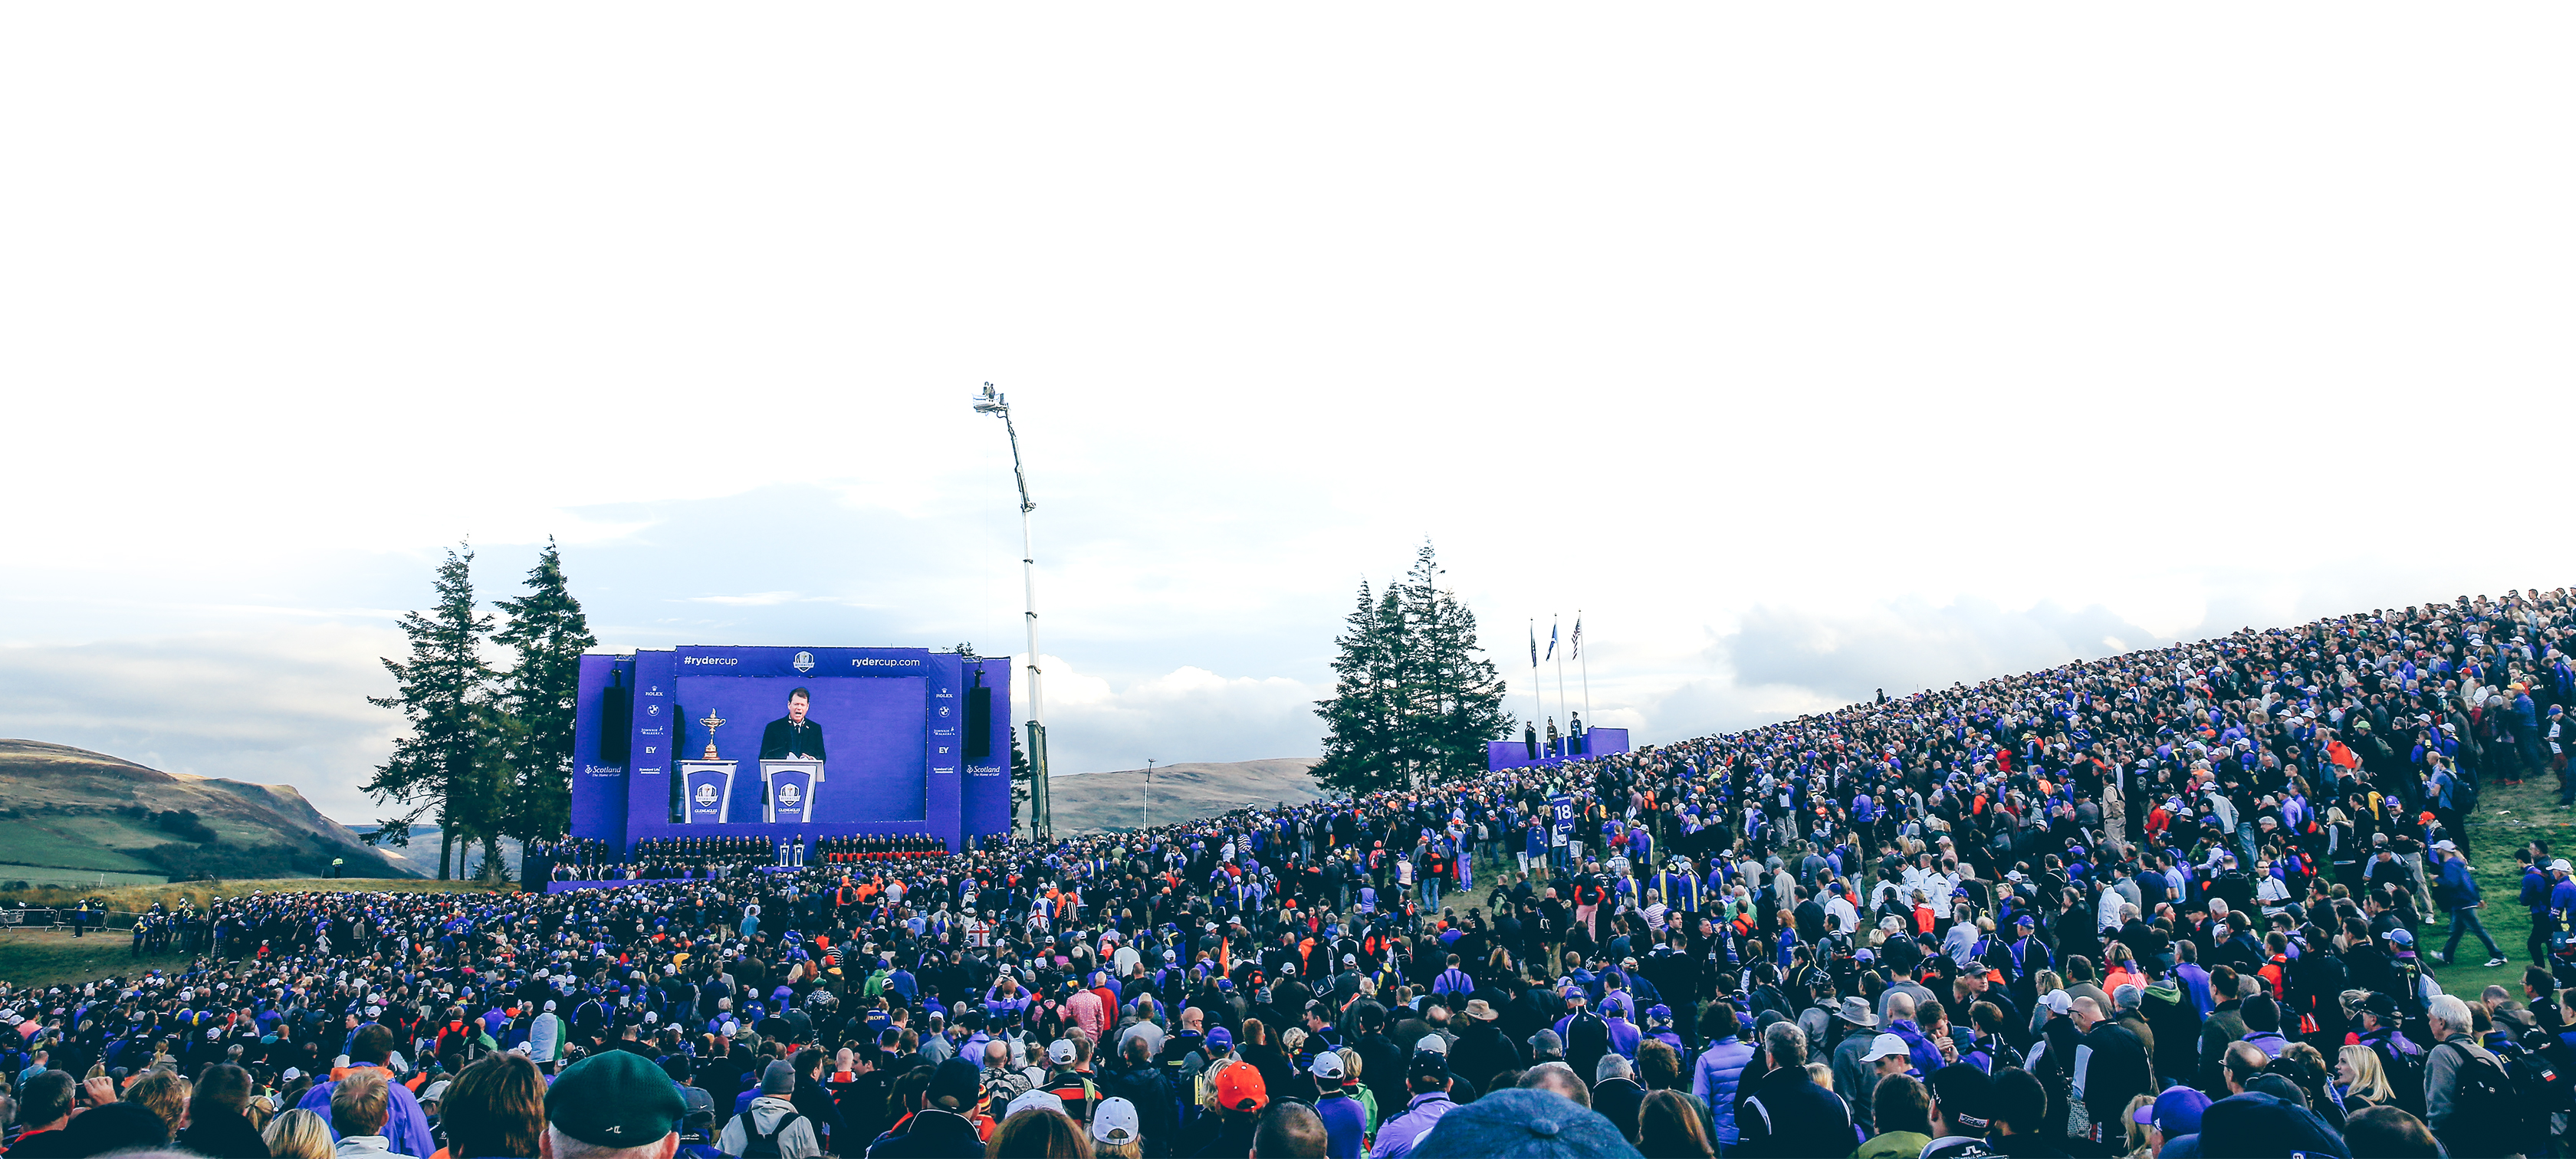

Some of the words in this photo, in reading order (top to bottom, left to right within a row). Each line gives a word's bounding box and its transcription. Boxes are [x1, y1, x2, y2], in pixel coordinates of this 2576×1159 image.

[684, 655, 738, 666] #rydercup
[852, 657, 920, 667] rydercup.com
[1555, 805, 1572, 820] 18
